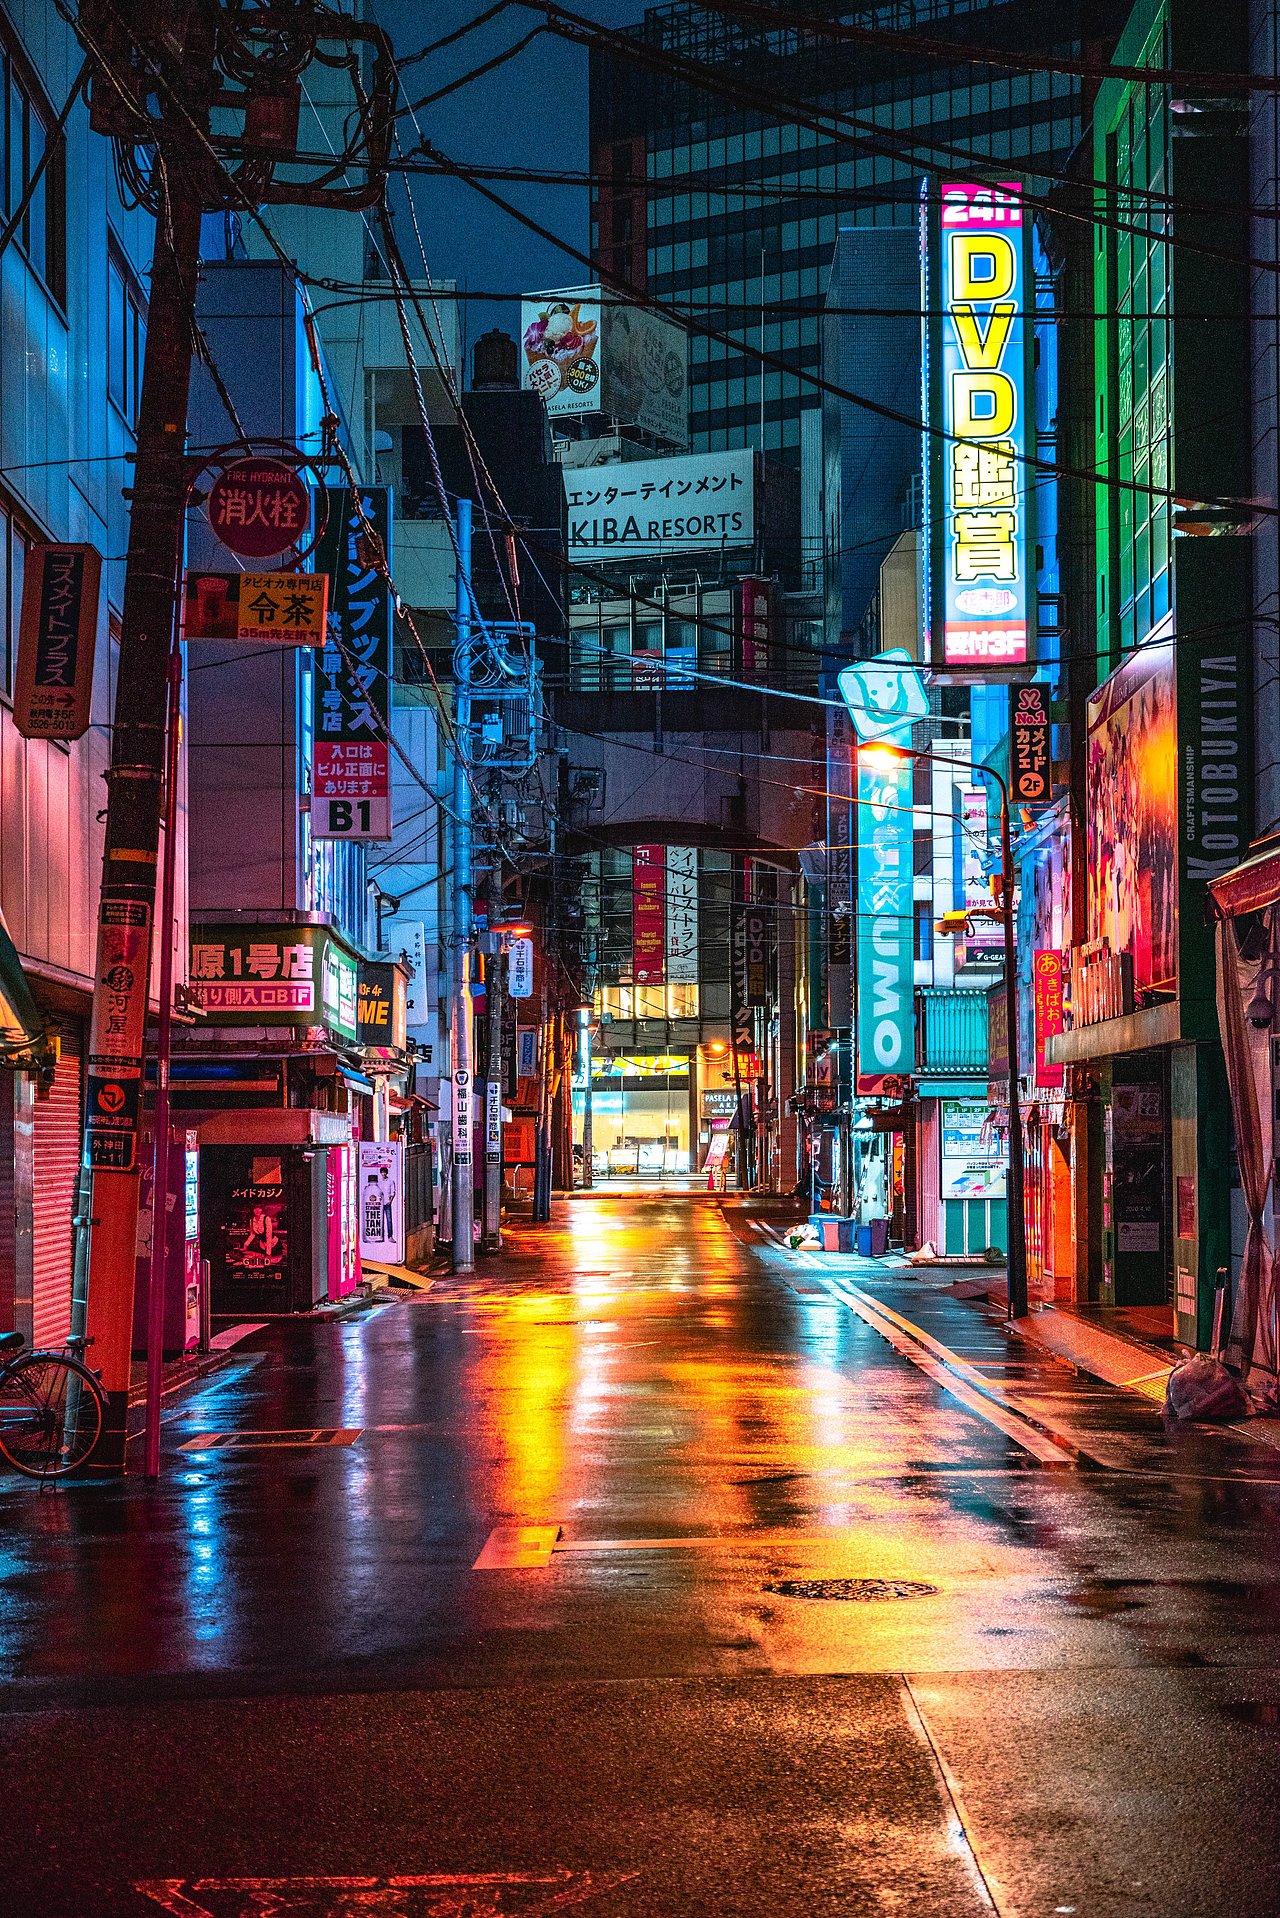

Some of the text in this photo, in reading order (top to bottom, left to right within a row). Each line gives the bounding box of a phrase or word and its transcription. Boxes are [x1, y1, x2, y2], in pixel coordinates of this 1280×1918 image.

[943, 190, 1021, 223] 24H
[567, 400, 594, 409] RESORTS
[227, 470, 293, 484] FIRE HYDRANT
[568, 472, 743, 508] エンターテインメント
[218, 487, 299, 528] 消火栓
[571, 512, 743, 547] KIBA RESORTS
[242, 577, 323, 592] タピオカ専門店
[248, 591, 315, 626] 令茶
[42, 553, 75, 685] コスメイトプラス
[1015, 710, 1047, 726] No.1
[330, 745, 373, 760] 入口は
[1016, 728, 1031, 769] カフェ
[1032, 728, 1047, 772] メイド
[317, 762, 386, 777] ビル正面に
[1186, 655, 1240, 880] KOTOBUKIYA
[324, 779, 378, 795] あります。
[1023, 778, 1041, 792] 2F
[1186, 745, 1195, 841] CRAFTSMANSHIP
[328, 800, 371, 832] B1
[871, 771, 903, 1068] SUKUMO
[190, 943, 314, 979] 原1号店
[371, 984, 383, 997] 4F
[704, 1094, 732, 1102] PASELA
[457, 1088, 468, 1139] 福山歯科
[93, 1139, 124, 1150] 外神田
[232, 1188, 283, 1198] メイドカジノ
[365, 1211, 381, 1220] THE
[365, 1219, 381, 1228] TAN
[365, 1228, 381, 1237] SAN
